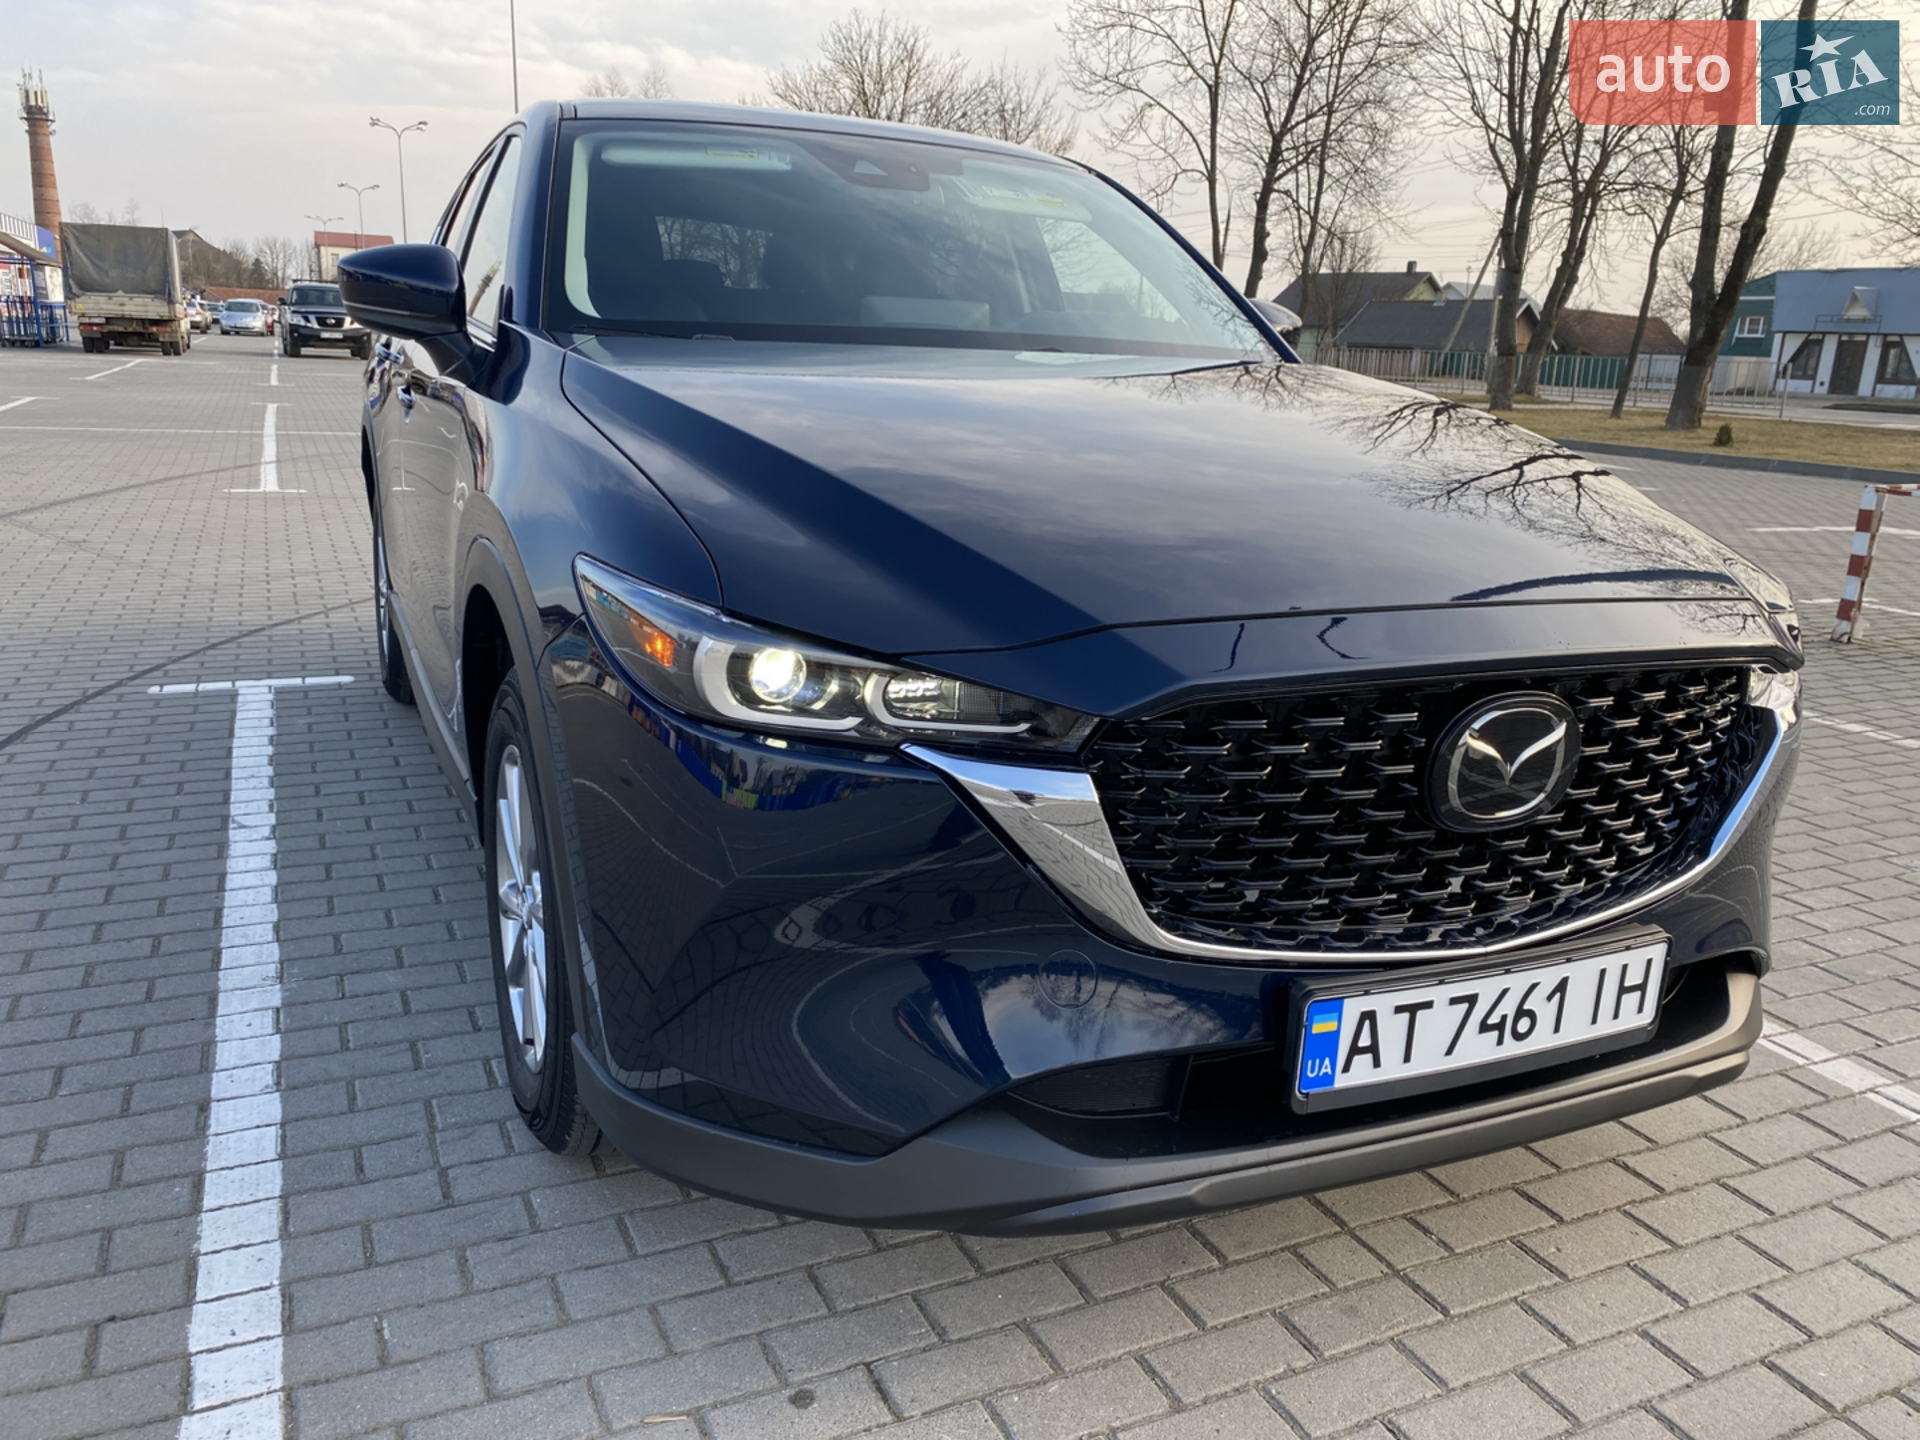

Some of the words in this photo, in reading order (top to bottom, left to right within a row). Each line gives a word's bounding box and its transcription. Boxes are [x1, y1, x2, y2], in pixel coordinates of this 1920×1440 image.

[1340, 999, 1434, 1074] AT
[1443, 975, 1571, 1057] 7461
[1590, 957, 1654, 1026] IH
[1306, 1057, 1332, 1078] UA
